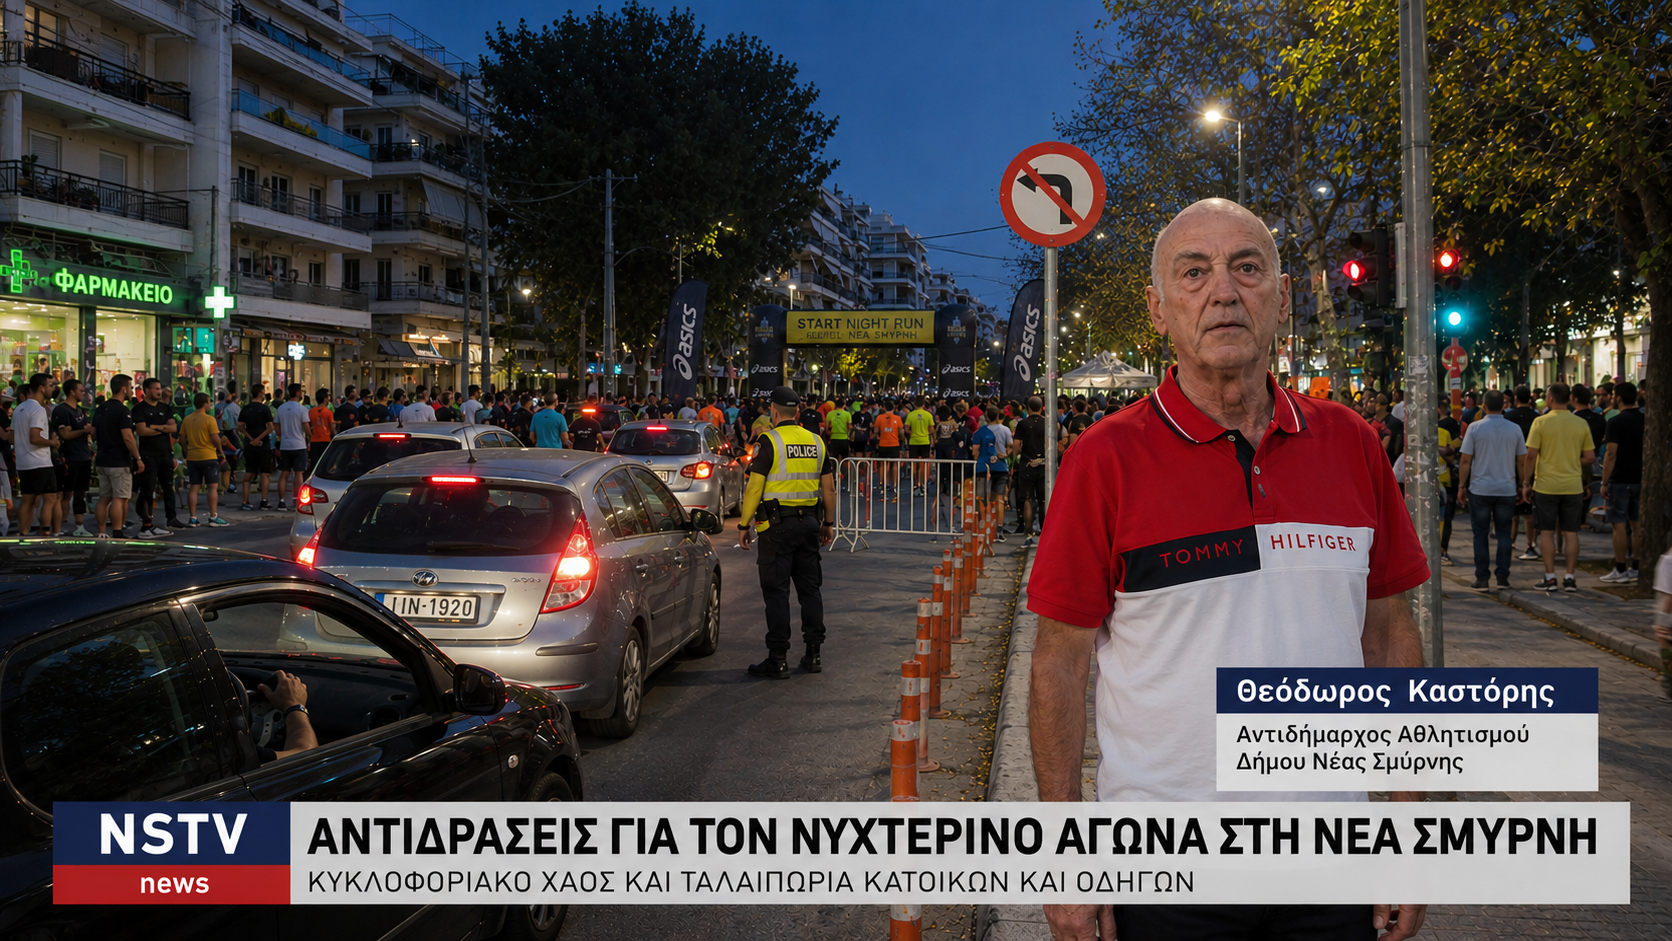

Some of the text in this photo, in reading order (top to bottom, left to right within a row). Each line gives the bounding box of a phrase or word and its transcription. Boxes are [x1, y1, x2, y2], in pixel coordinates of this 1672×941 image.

[55, 267, 174, 304] ΦΑΡΜΑΚΕΙΟ
[678, 303, 697, 358] asics
[797, 317, 924, 330] START NIGHT RUN
[1020, 303, 1040, 359] asics
[787, 445, 818, 458] POLICE
[1159, 533, 1356, 568] TOMMY HILFIGER
